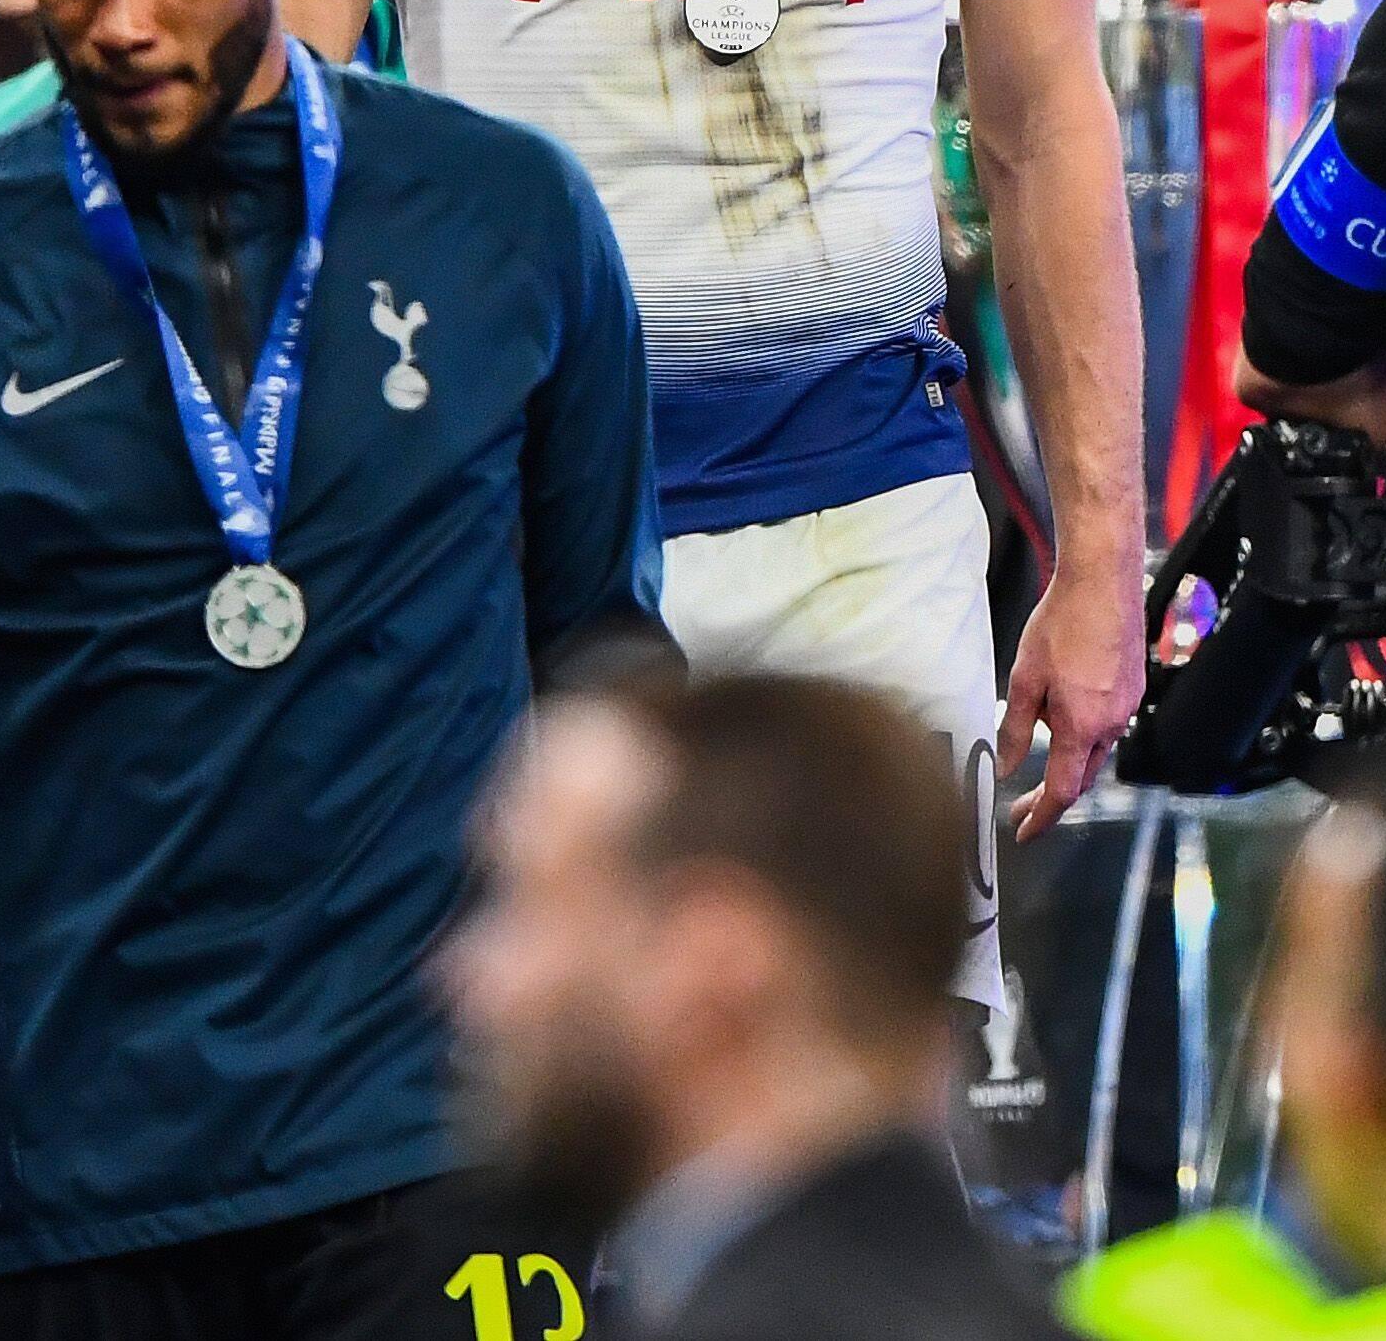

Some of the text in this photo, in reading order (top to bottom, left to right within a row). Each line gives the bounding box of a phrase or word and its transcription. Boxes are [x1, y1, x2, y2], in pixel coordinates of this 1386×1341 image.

[692, 18, 771, 32] CHAMPIONS
[711, 32, 752, 41] LEAGUE
[202, 412, 244, 507] FINAL
